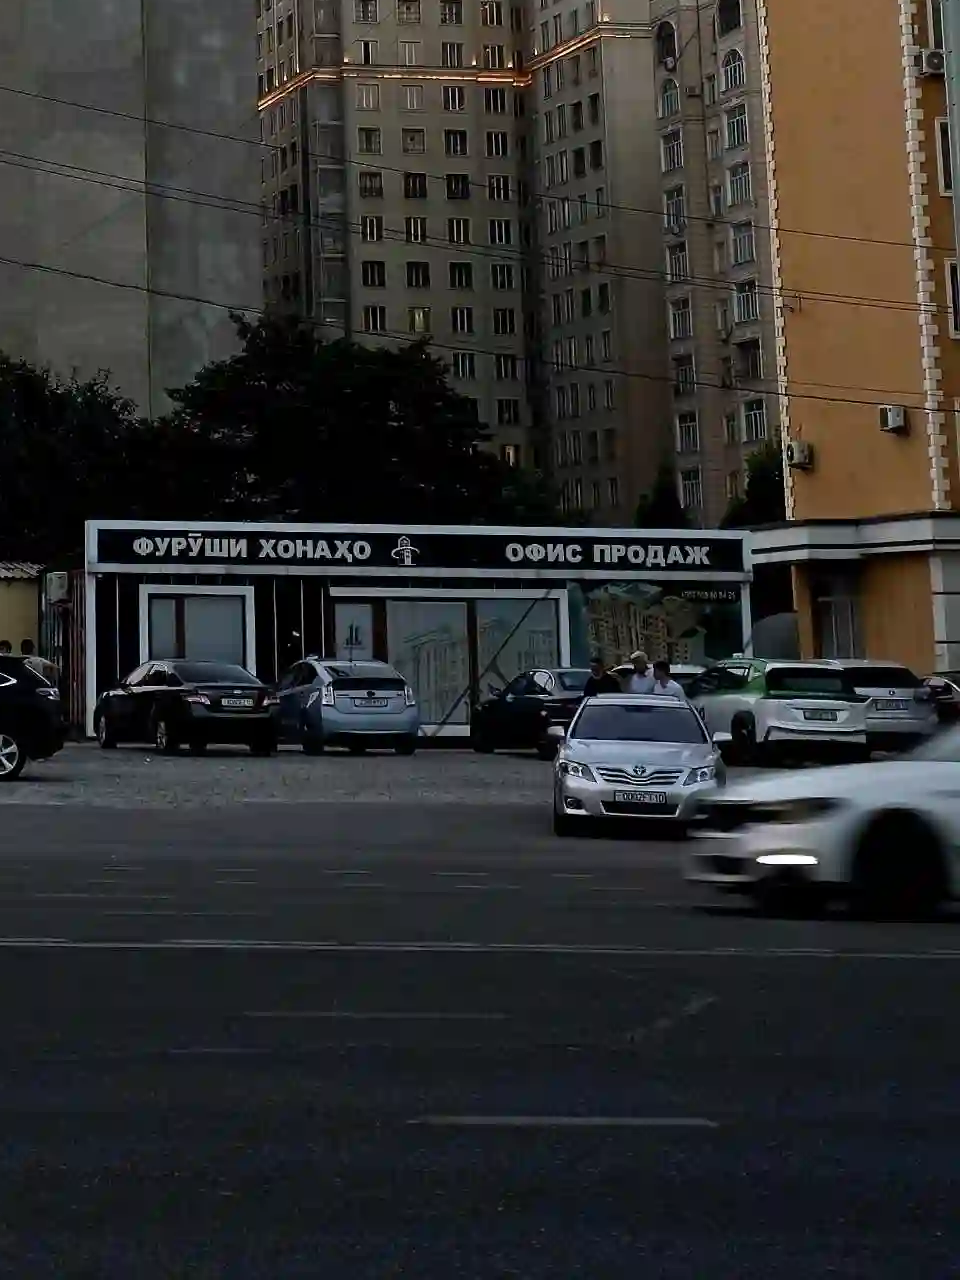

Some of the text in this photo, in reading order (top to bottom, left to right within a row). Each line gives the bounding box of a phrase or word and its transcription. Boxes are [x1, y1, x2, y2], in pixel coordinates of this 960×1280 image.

[133, 533, 372, 563] ФУРӮШИ ХОНАҲО
[505, 543, 710, 567] ОФИС ПРОДАЖ
